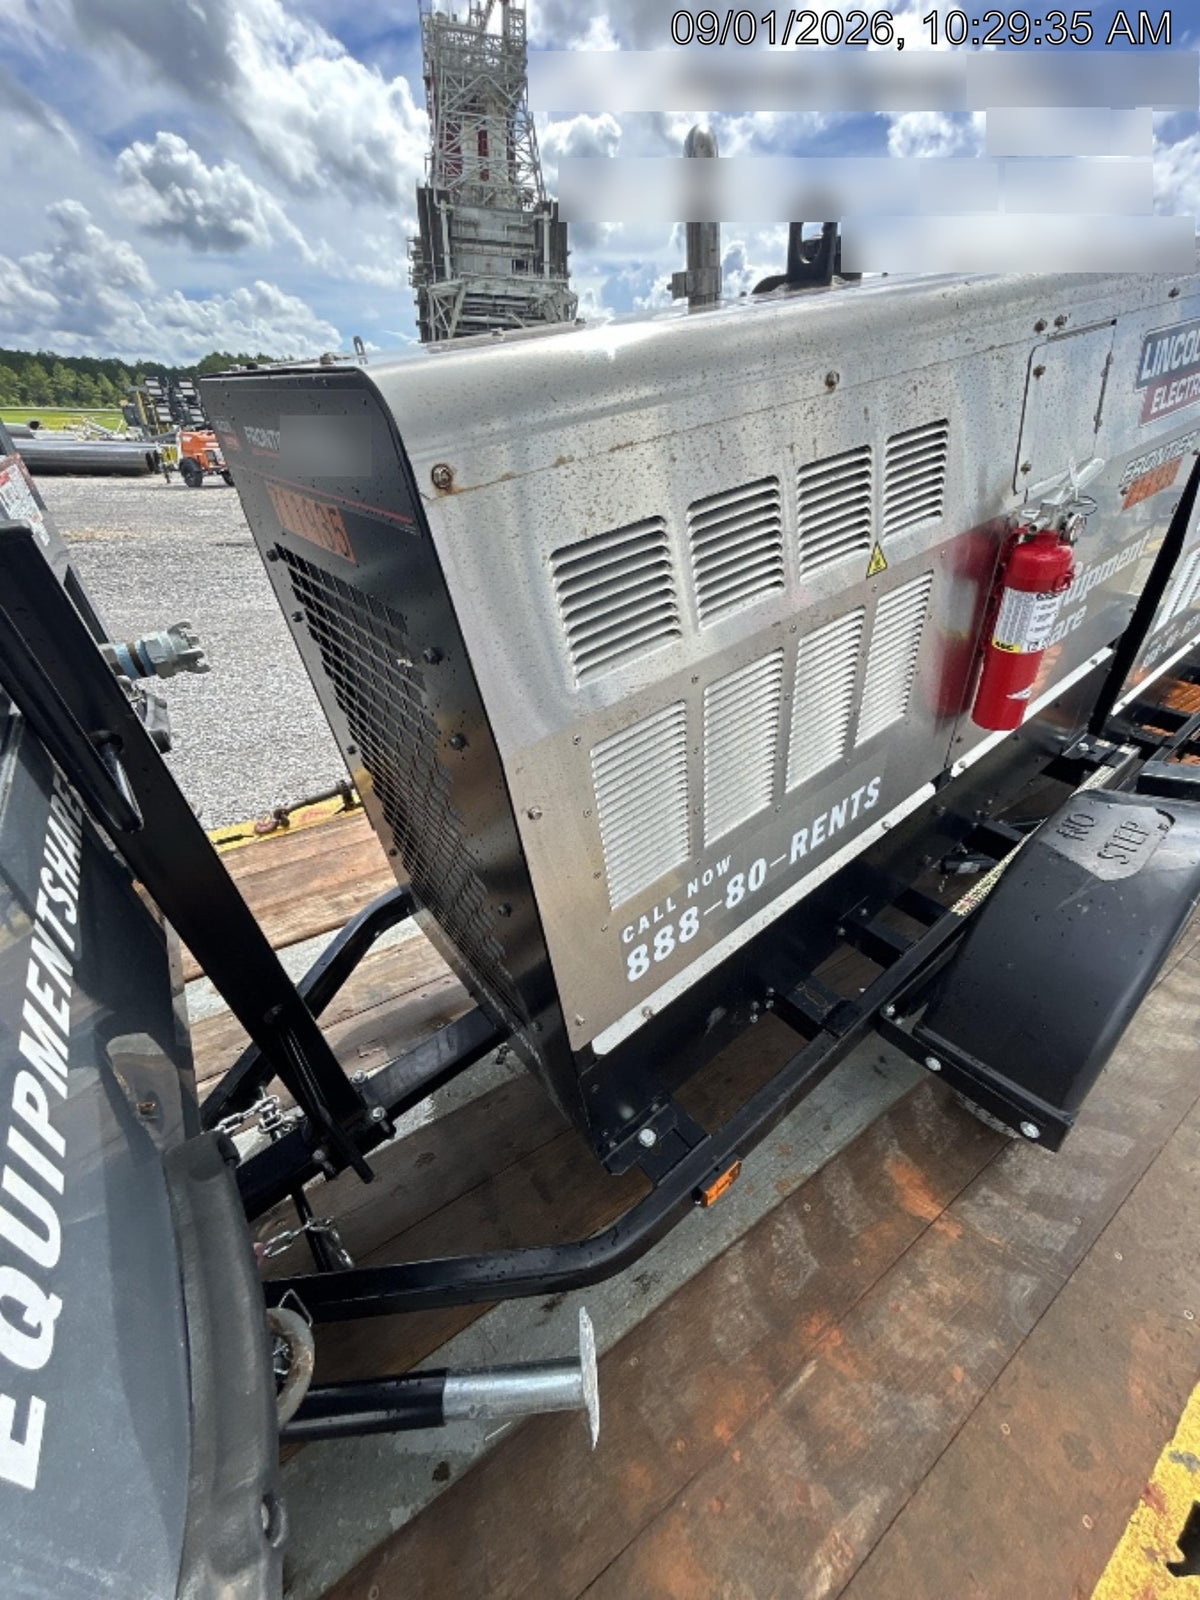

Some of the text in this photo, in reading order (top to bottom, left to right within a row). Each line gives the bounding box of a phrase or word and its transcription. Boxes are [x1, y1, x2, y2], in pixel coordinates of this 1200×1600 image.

[1060, 529, 1151, 607] uipment
[1056, 812, 1096, 842] NO
[1096, 820, 1149, 866] STEP
[622, 854, 732, 944] CALL NOW
